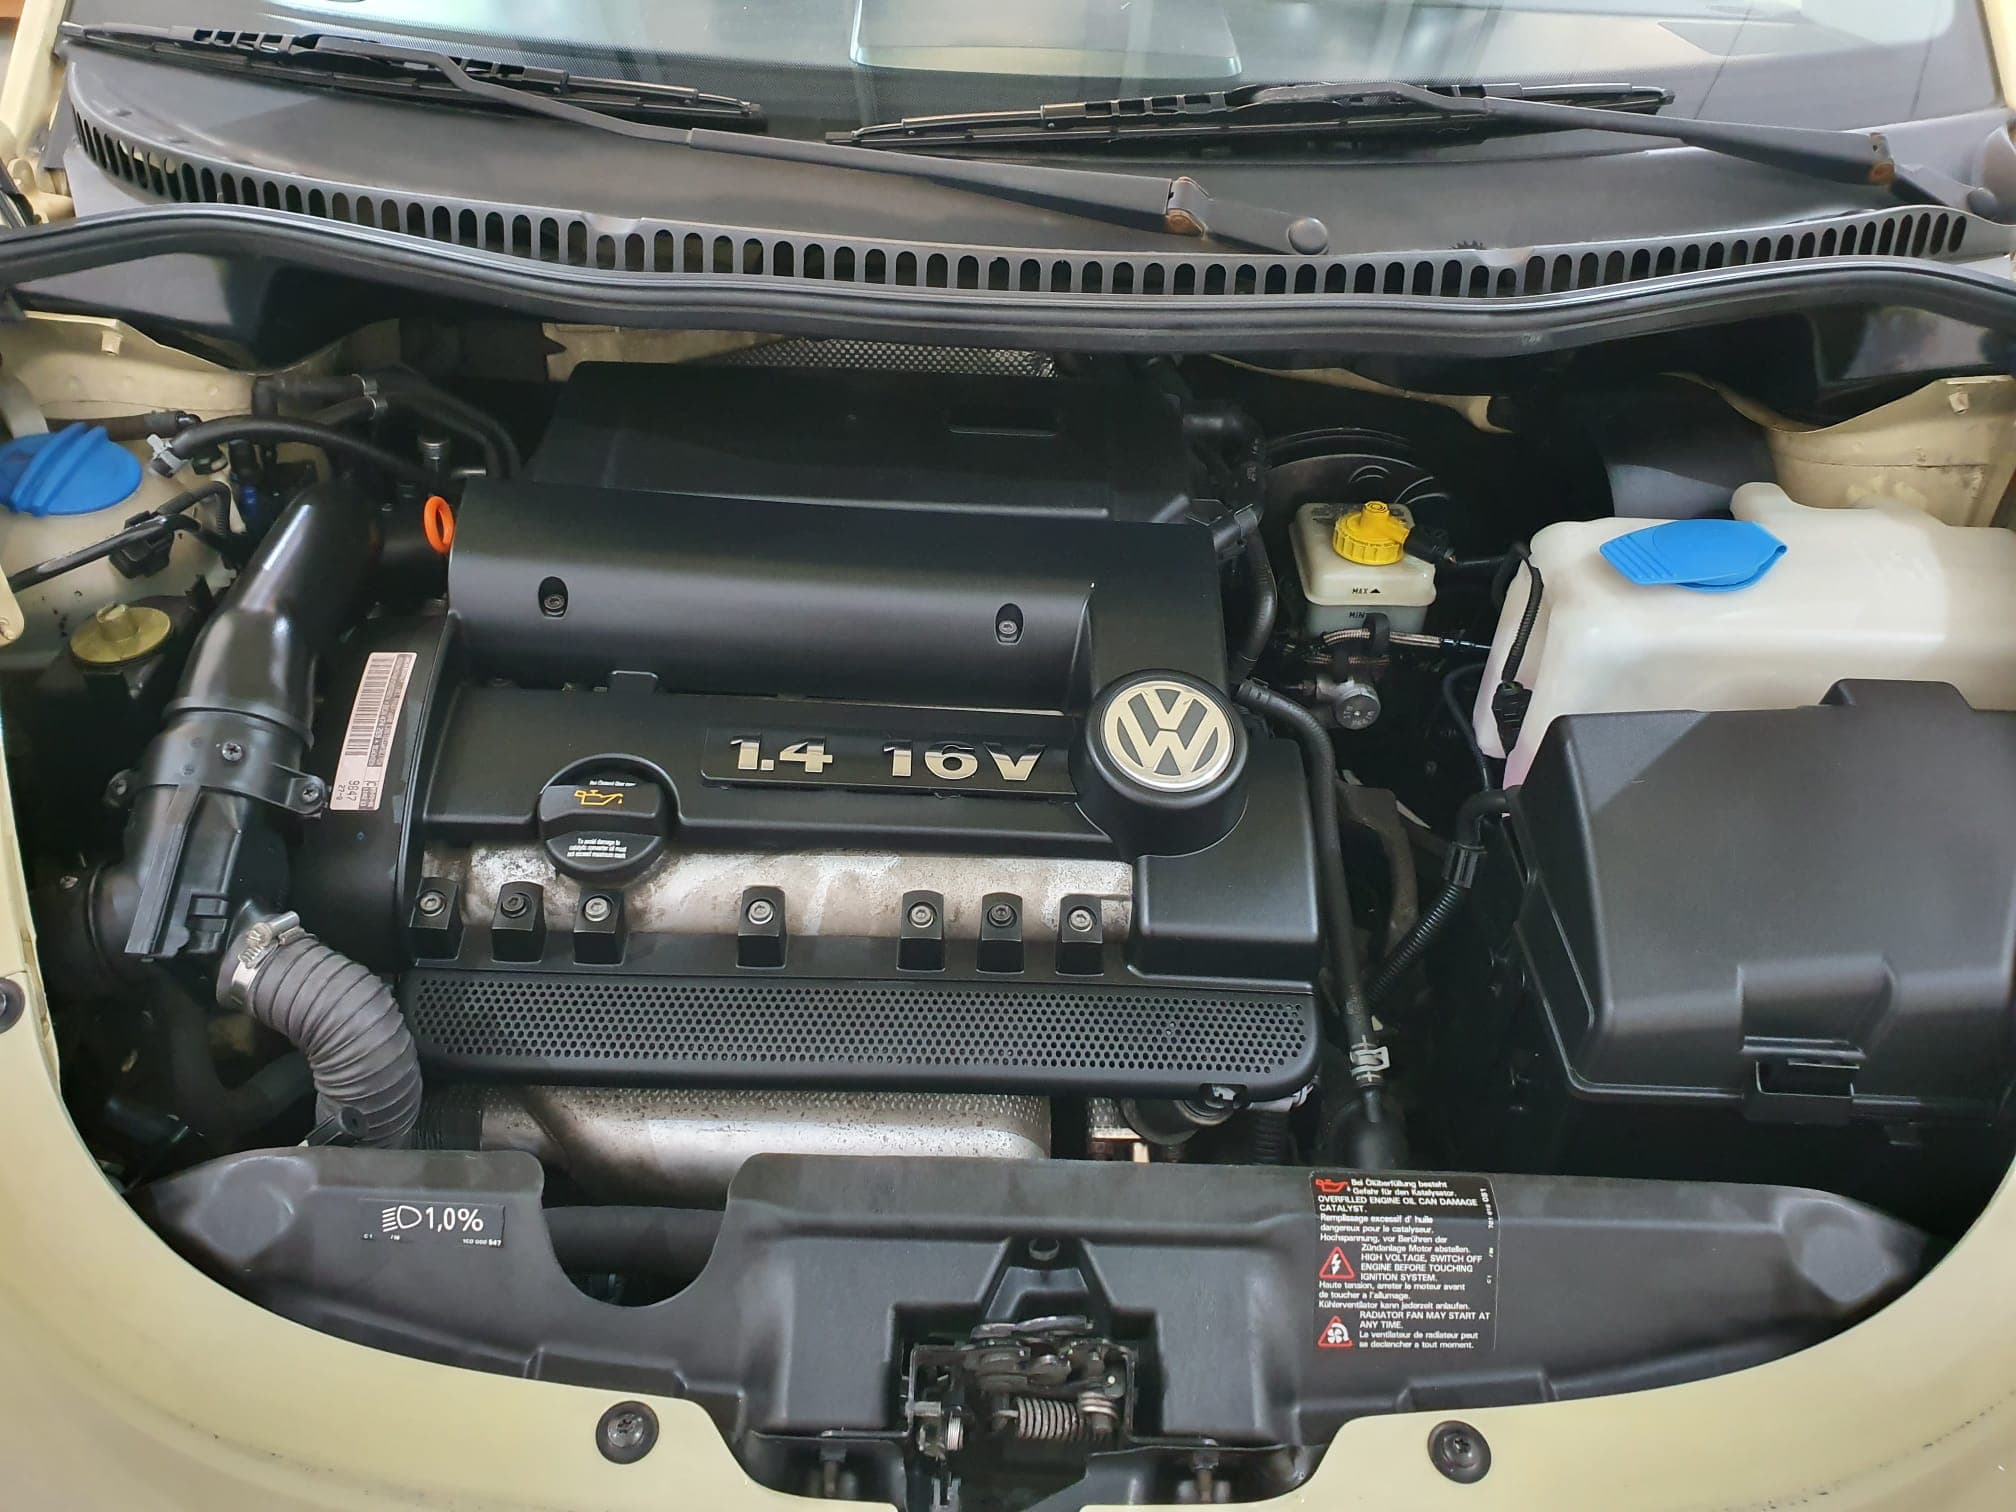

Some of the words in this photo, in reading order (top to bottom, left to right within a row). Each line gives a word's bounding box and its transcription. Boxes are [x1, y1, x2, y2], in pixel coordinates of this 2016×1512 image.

[730, 735, 833, 773] 1.4
[884, 739, 1047, 781] 16V
[1318, 1195, 1367, 1204] OVERFILLED
[1402, 1197, 1417, 1205] OIL
[1439, 1198, 1478, 1206] DAMAGE
[426, 1207, 484, 1232] 1,0%
[1363, 1225, 1380, 1234] pour
[1382, 1225, 1390, 1233] le
[1430, 1255, 1465, 1263] SWITCH
[1466, 1255, 1482, 1263] OFF
[1361, 1263, 1392, 1271] ENGINE
[1394, 1264, 1426, 1272] BEFORE
[1429, 1264, 1473, 1272] TOUCHING
[1400, 1273, 1437, 1281] SYSTEM.
[1319, 1281, 1342, 1289] Haute
[1380, 1301, 1399, 1309] kann
[1359, 1311, 1403, 1319] RADIATOR
[1448, 1312, 1476, 1320] START
[1478, 1312, 1490, 1320] AT
[1381, 1321, 1403, 1329] TIME.
